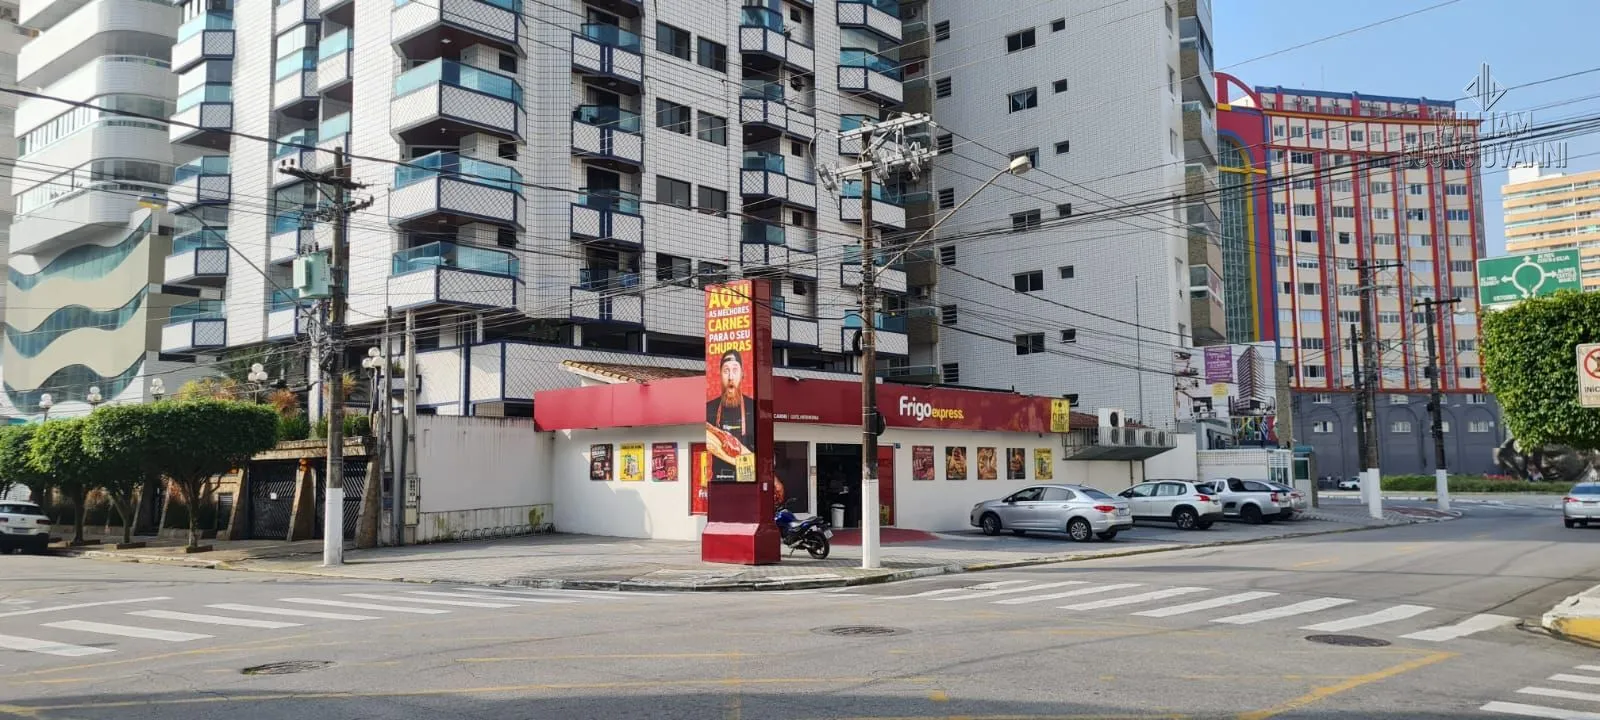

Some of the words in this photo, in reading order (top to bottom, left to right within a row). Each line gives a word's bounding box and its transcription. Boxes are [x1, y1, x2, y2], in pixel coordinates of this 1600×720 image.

[708, 283, 749, 309] AQUI
[709, 310, 717, 318] AS
[717, 306, 750, 317] MELHORES
[708, 315, 750, 333] CARNES
[709, 331, 729, 342] PARA
[729, 331, 735, 340] O
[736, 329, 751, 339] SEU
[708, 339, 752, 355] CHURRAS
